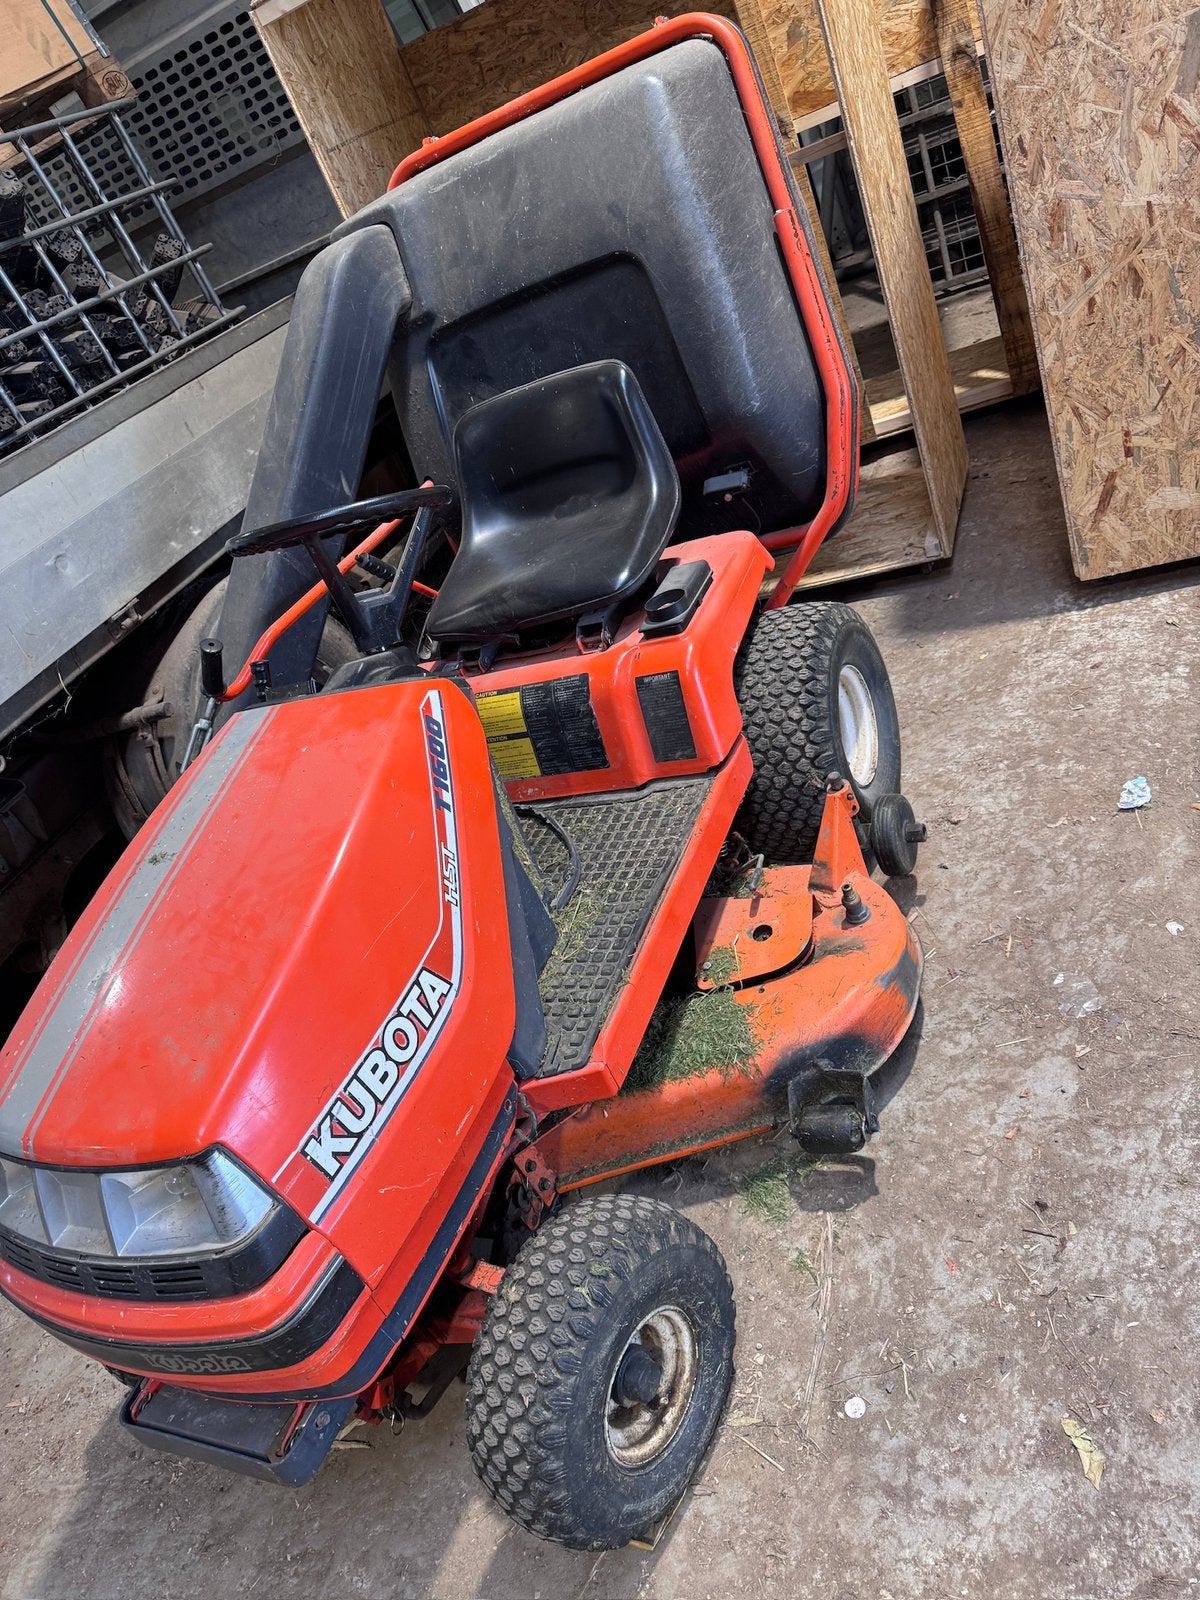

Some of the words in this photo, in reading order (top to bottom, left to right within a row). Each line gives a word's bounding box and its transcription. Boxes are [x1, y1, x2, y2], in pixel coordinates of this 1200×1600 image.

[643, 673, 671, 682] IMPORTANT
[475, 691, 497, 699] CAUTION
[486, 735, 508, 743] TENTION
[425, 714, 451, 813] T1600
[440, 844, 459, 907] HST
[300, 966, 453, 1182] KUBOTA
[142, 1353, 252, 1372] Kubota
